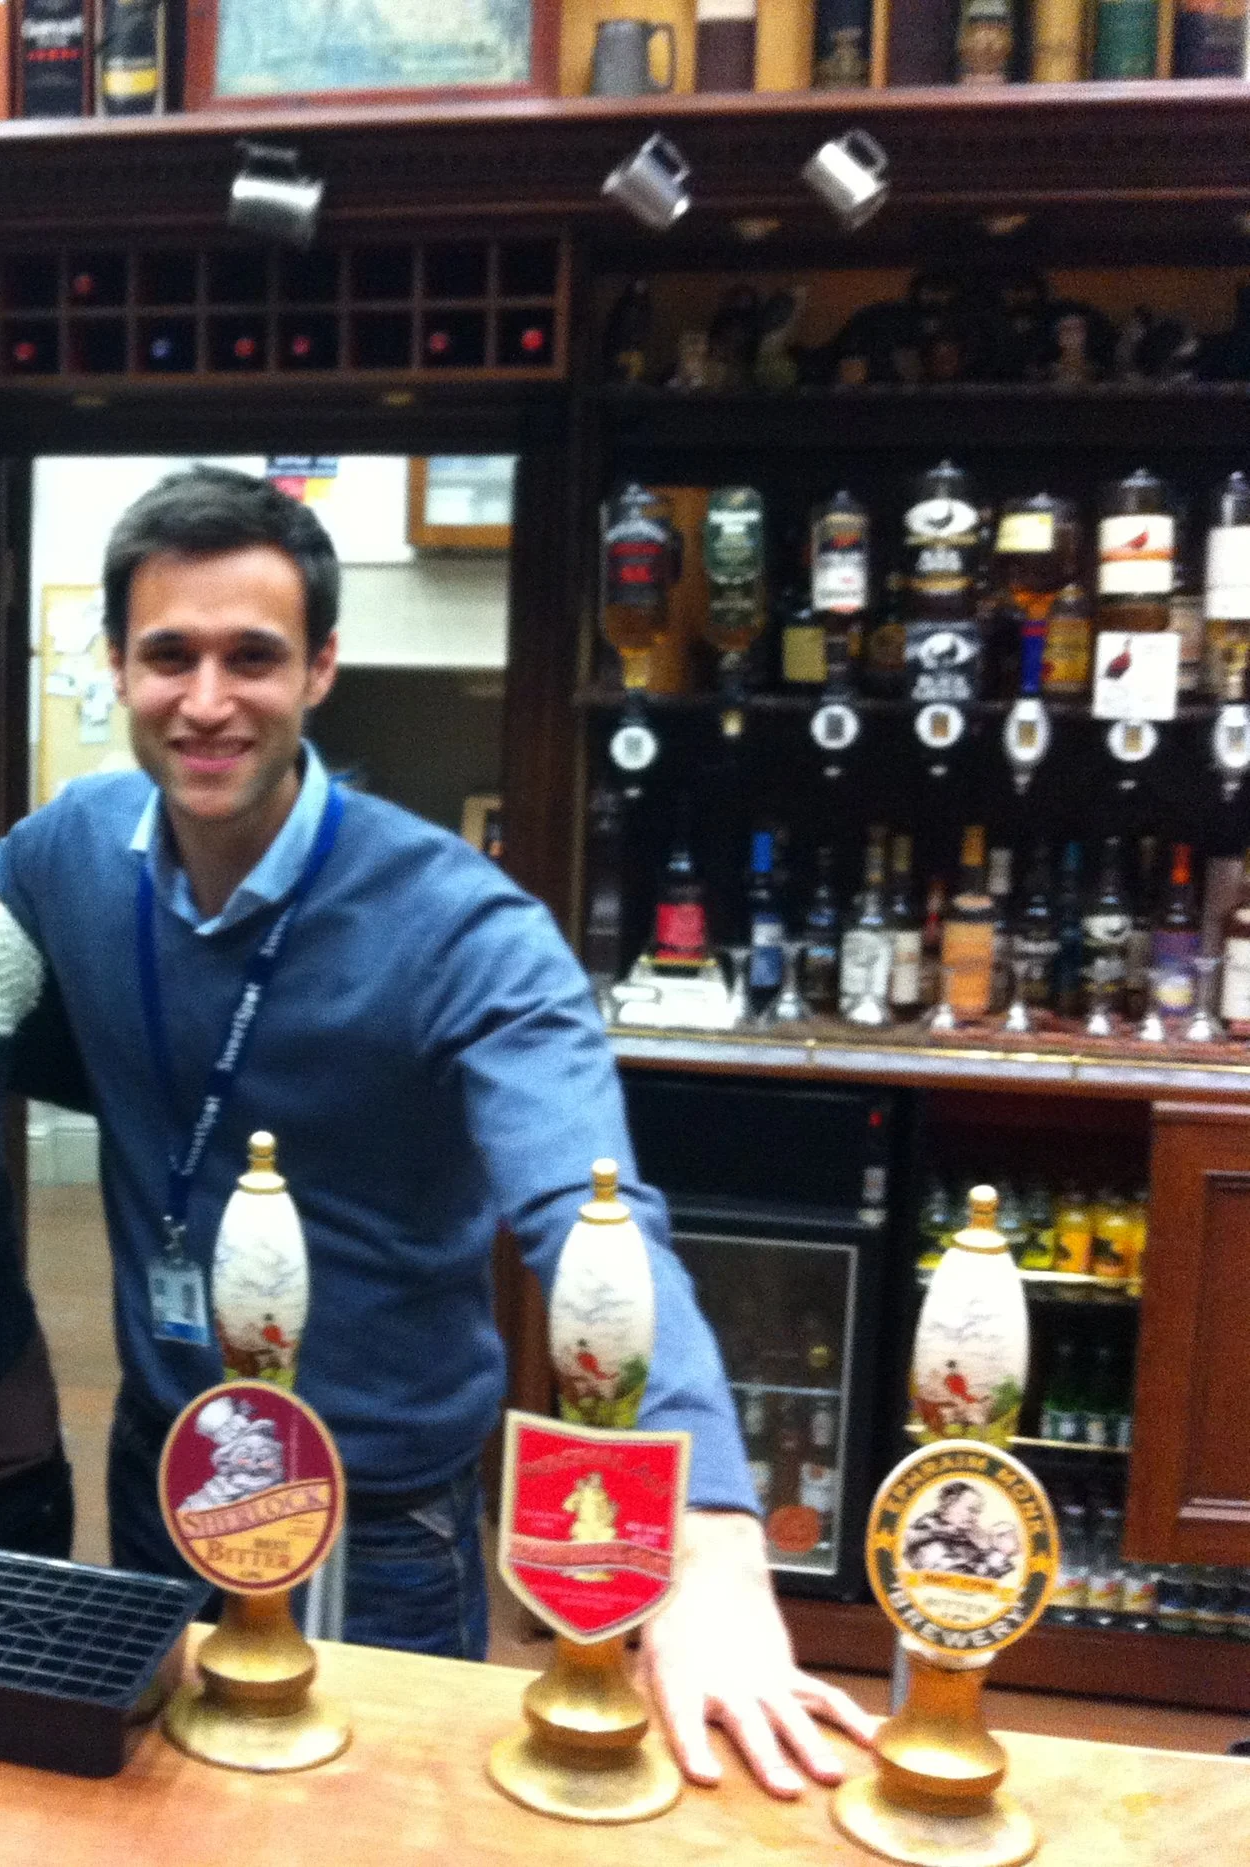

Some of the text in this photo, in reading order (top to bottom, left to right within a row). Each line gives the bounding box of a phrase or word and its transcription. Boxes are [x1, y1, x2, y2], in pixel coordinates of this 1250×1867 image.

[183, 1488, 324, 1536] SHERLOCK
[888, 1455, 1047, 1535] EPHRAIM MONK
[205, 1540, 292, 1570] BITTER
[888, 1588, 1028, 1647] BREWERY
